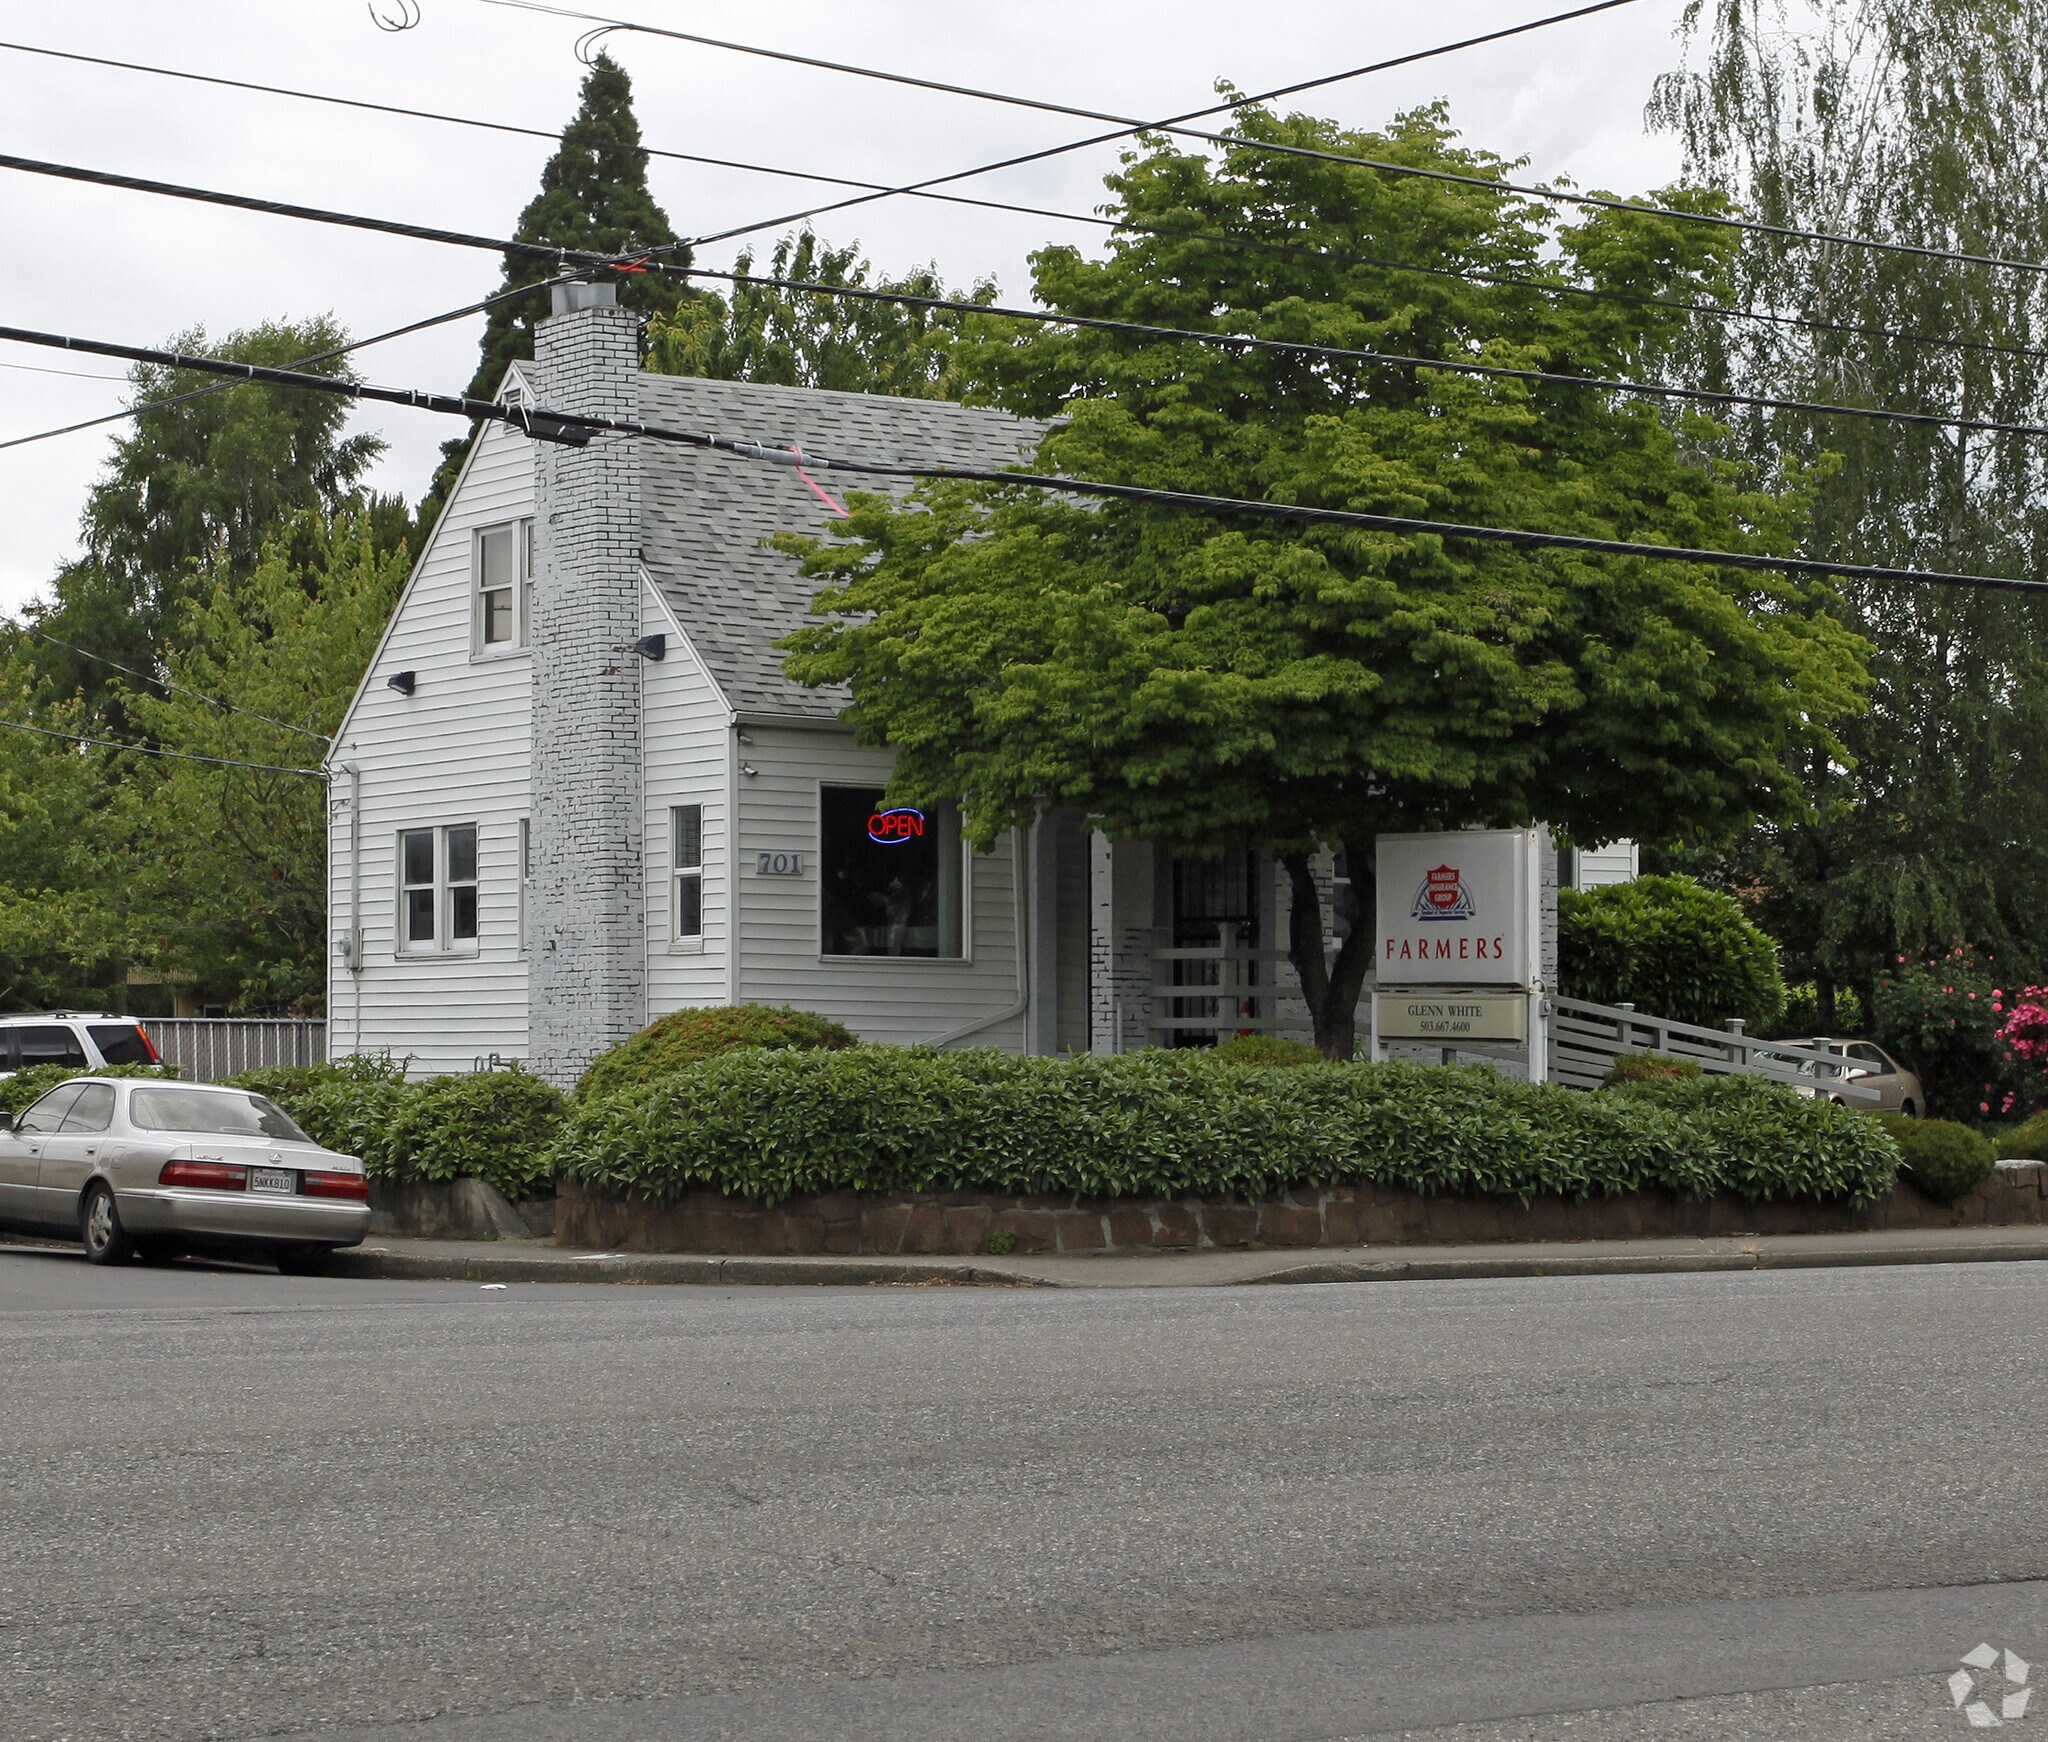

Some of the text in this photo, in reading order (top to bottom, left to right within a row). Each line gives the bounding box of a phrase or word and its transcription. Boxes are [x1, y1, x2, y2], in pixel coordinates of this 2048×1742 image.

[868, 814, 923, 836] OPEN
[759, 853, 801, 872] 701
[1431, 872, 1455, 881] FARMERS
[1386, 937, 1503, 959] FARMERS
[1408, 1005, 1483, 1017] GLENN WHITE
[1420, 1021, 1470, 1033] 503.667.4600
